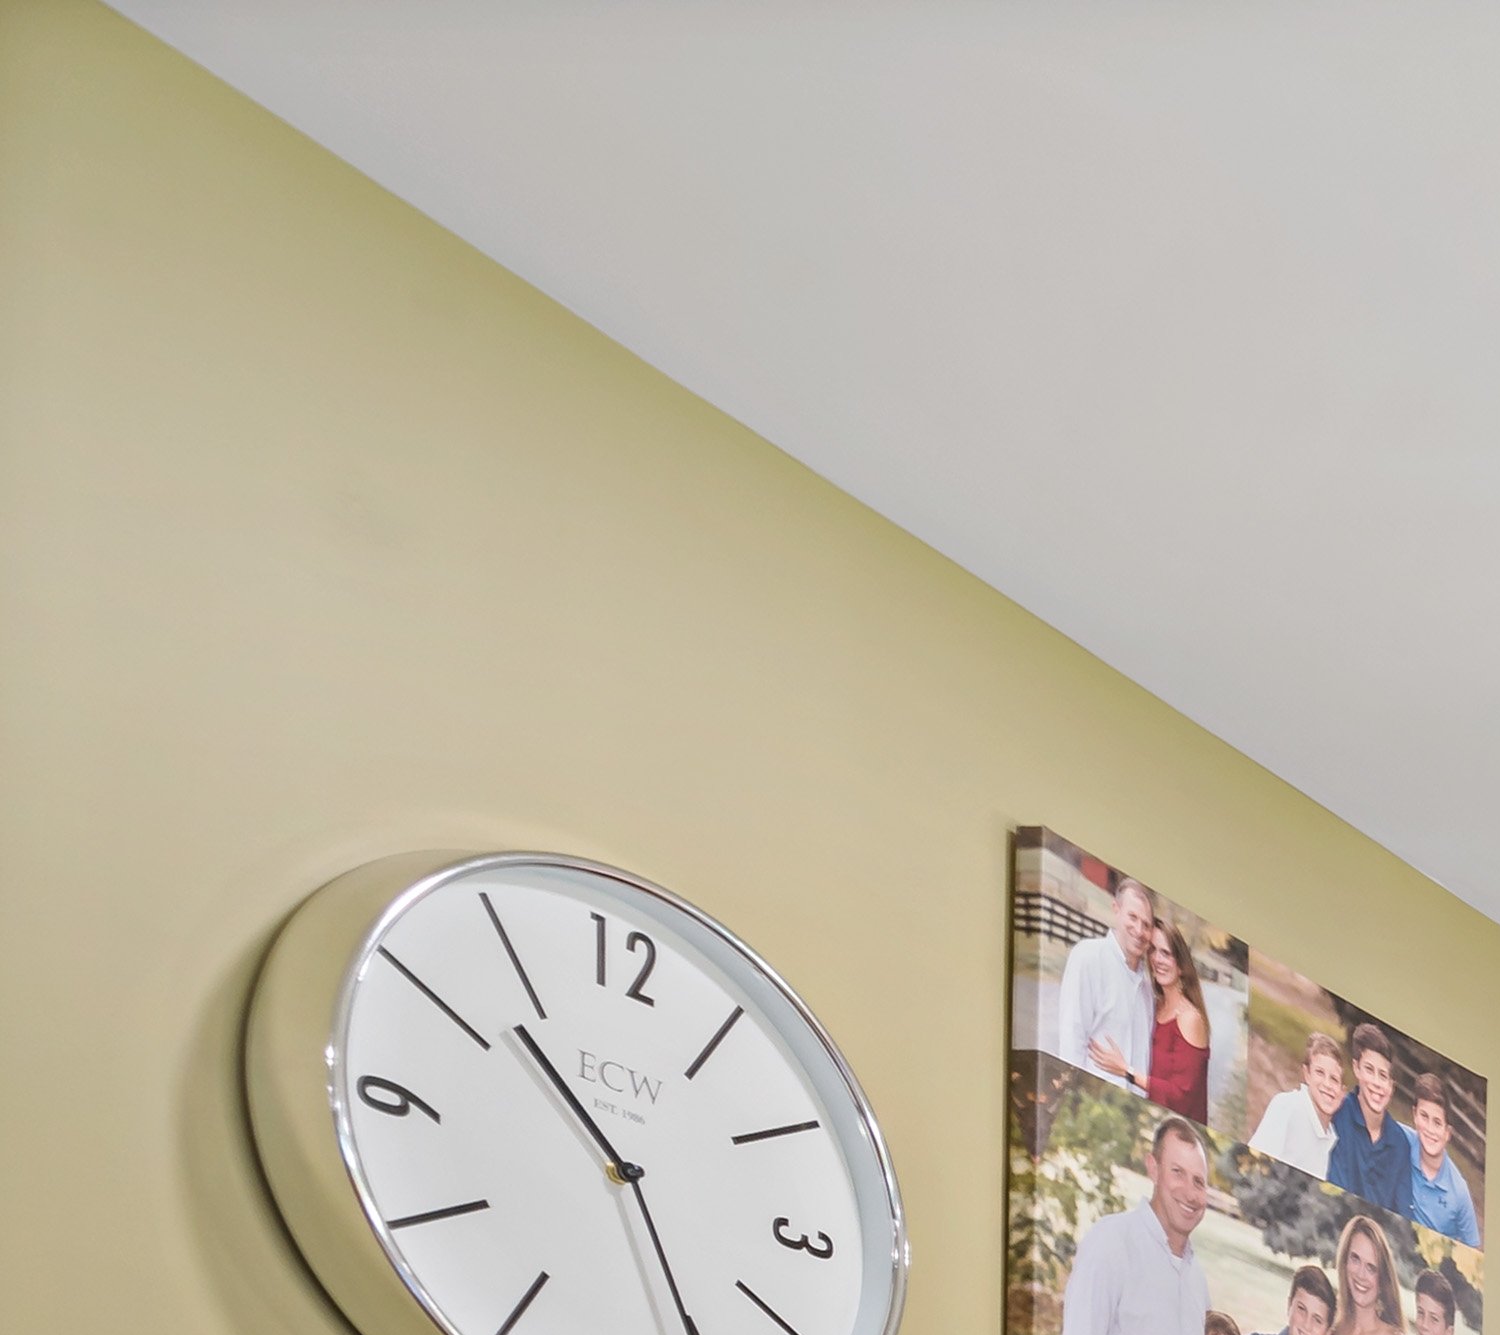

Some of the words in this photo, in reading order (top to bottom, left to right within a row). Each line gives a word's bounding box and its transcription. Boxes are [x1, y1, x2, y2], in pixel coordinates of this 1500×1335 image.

[589, 911, 656, 1006] 12
[356, 1074, 440, 1124] 9
[577, 1048, 662, 1105] ECW
[773, 1216, 834, 1261] 3
